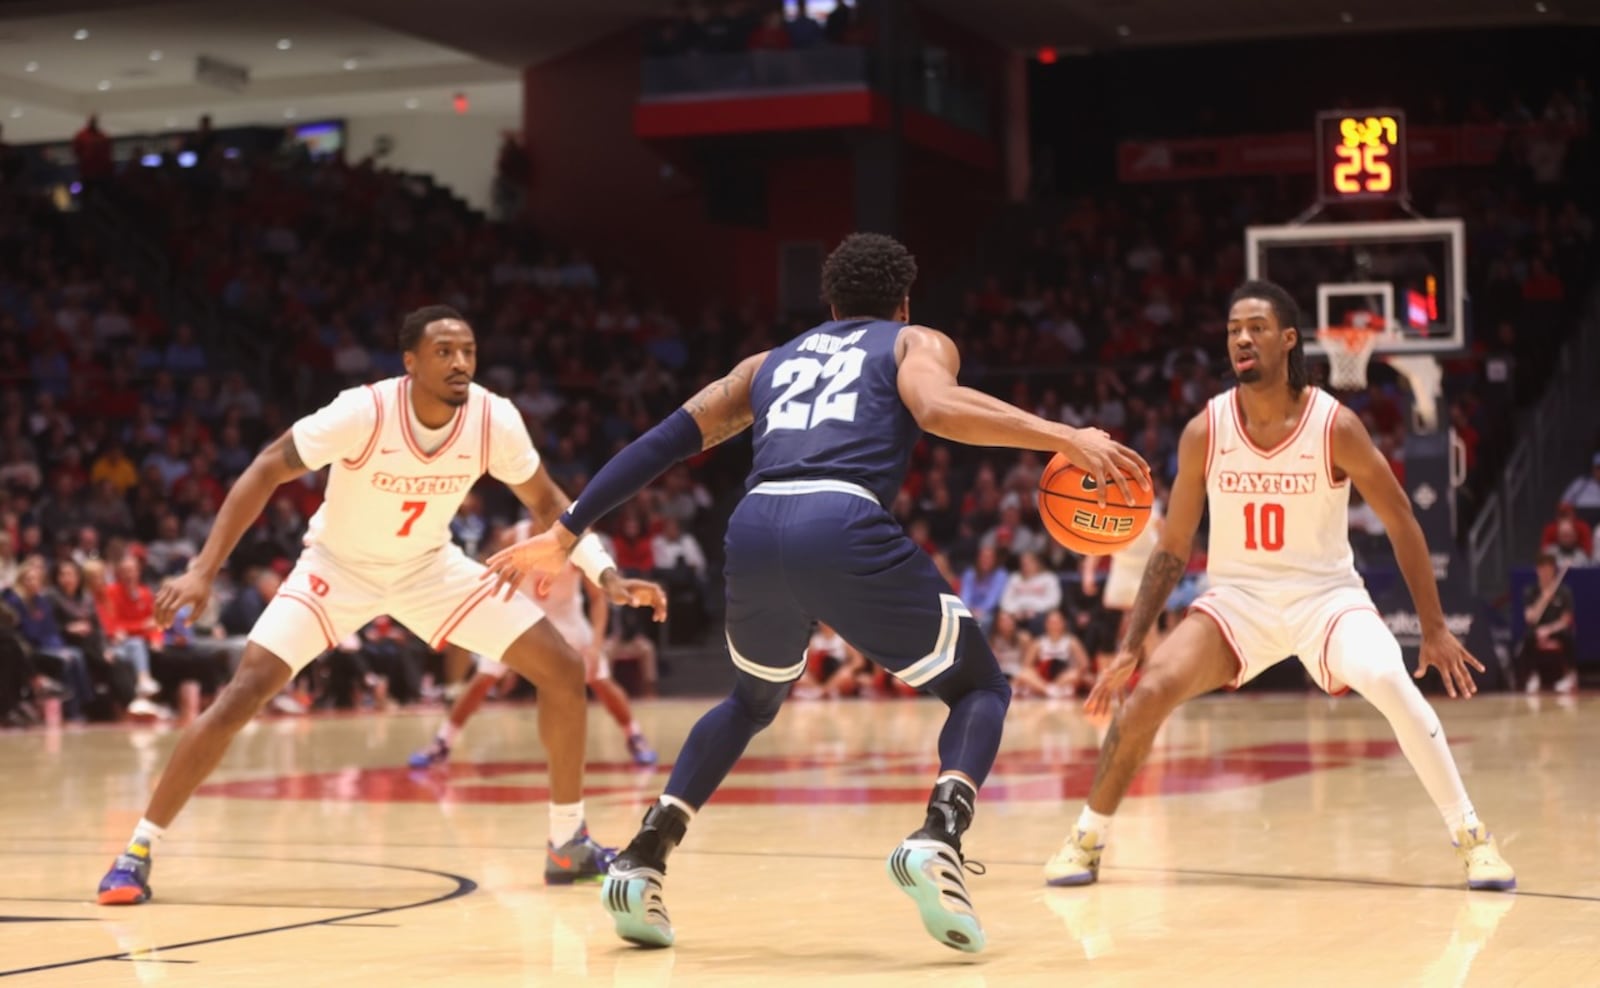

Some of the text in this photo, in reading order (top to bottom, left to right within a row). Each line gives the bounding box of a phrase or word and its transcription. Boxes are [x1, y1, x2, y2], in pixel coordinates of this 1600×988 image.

[1340, 117, 1397, 148] 5:27
[1334, 145, 1391, 193] 25
[762, 347, 868, 437] 22
[371, 471, 471, 495] DAYTON
[1219, 471, 1316, 494] DAYTON
[396, 501, 427, 537] 7
[1072, 508, 1135, 533] ELITE
[1243, 502, 1285, 551] 10
